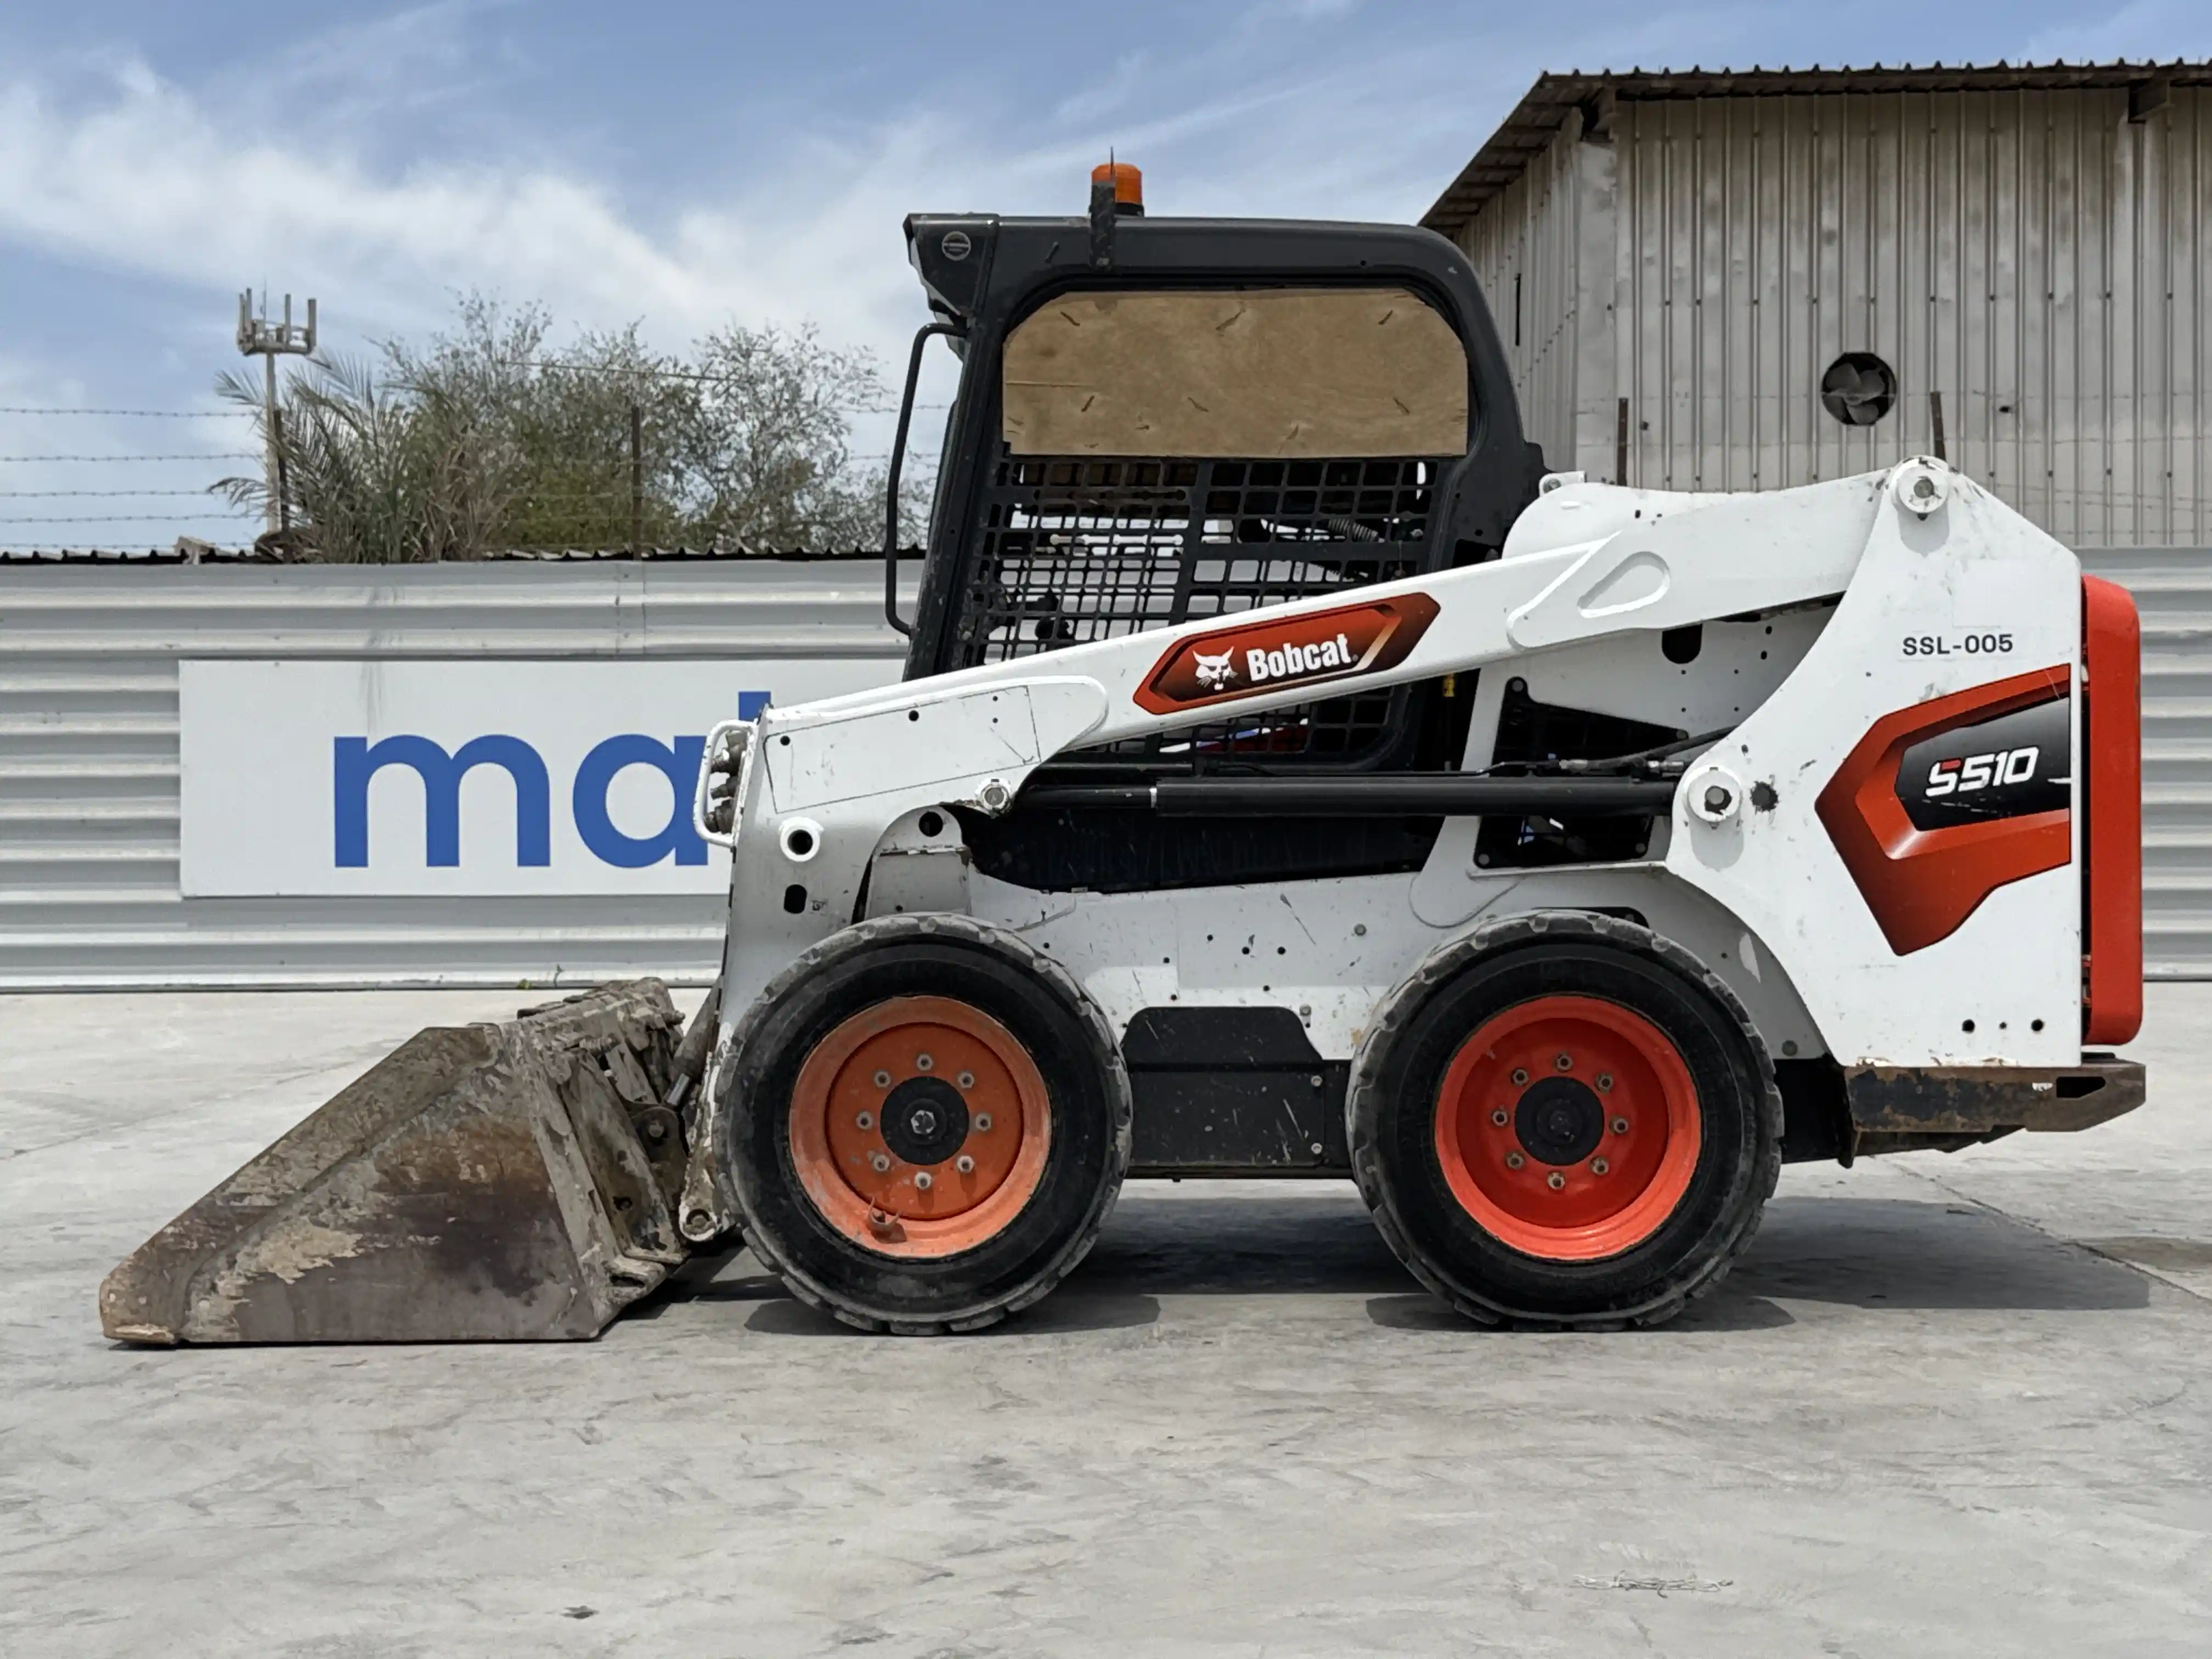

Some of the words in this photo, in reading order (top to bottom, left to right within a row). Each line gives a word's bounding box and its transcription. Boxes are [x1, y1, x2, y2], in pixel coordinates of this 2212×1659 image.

[1246, 633, 1352, 681] Bobcat
[1902, 634, 2013, 656] SSL-005
[335, 691, 771, 868] ma
[1925, 747, 2039, 797] S510
